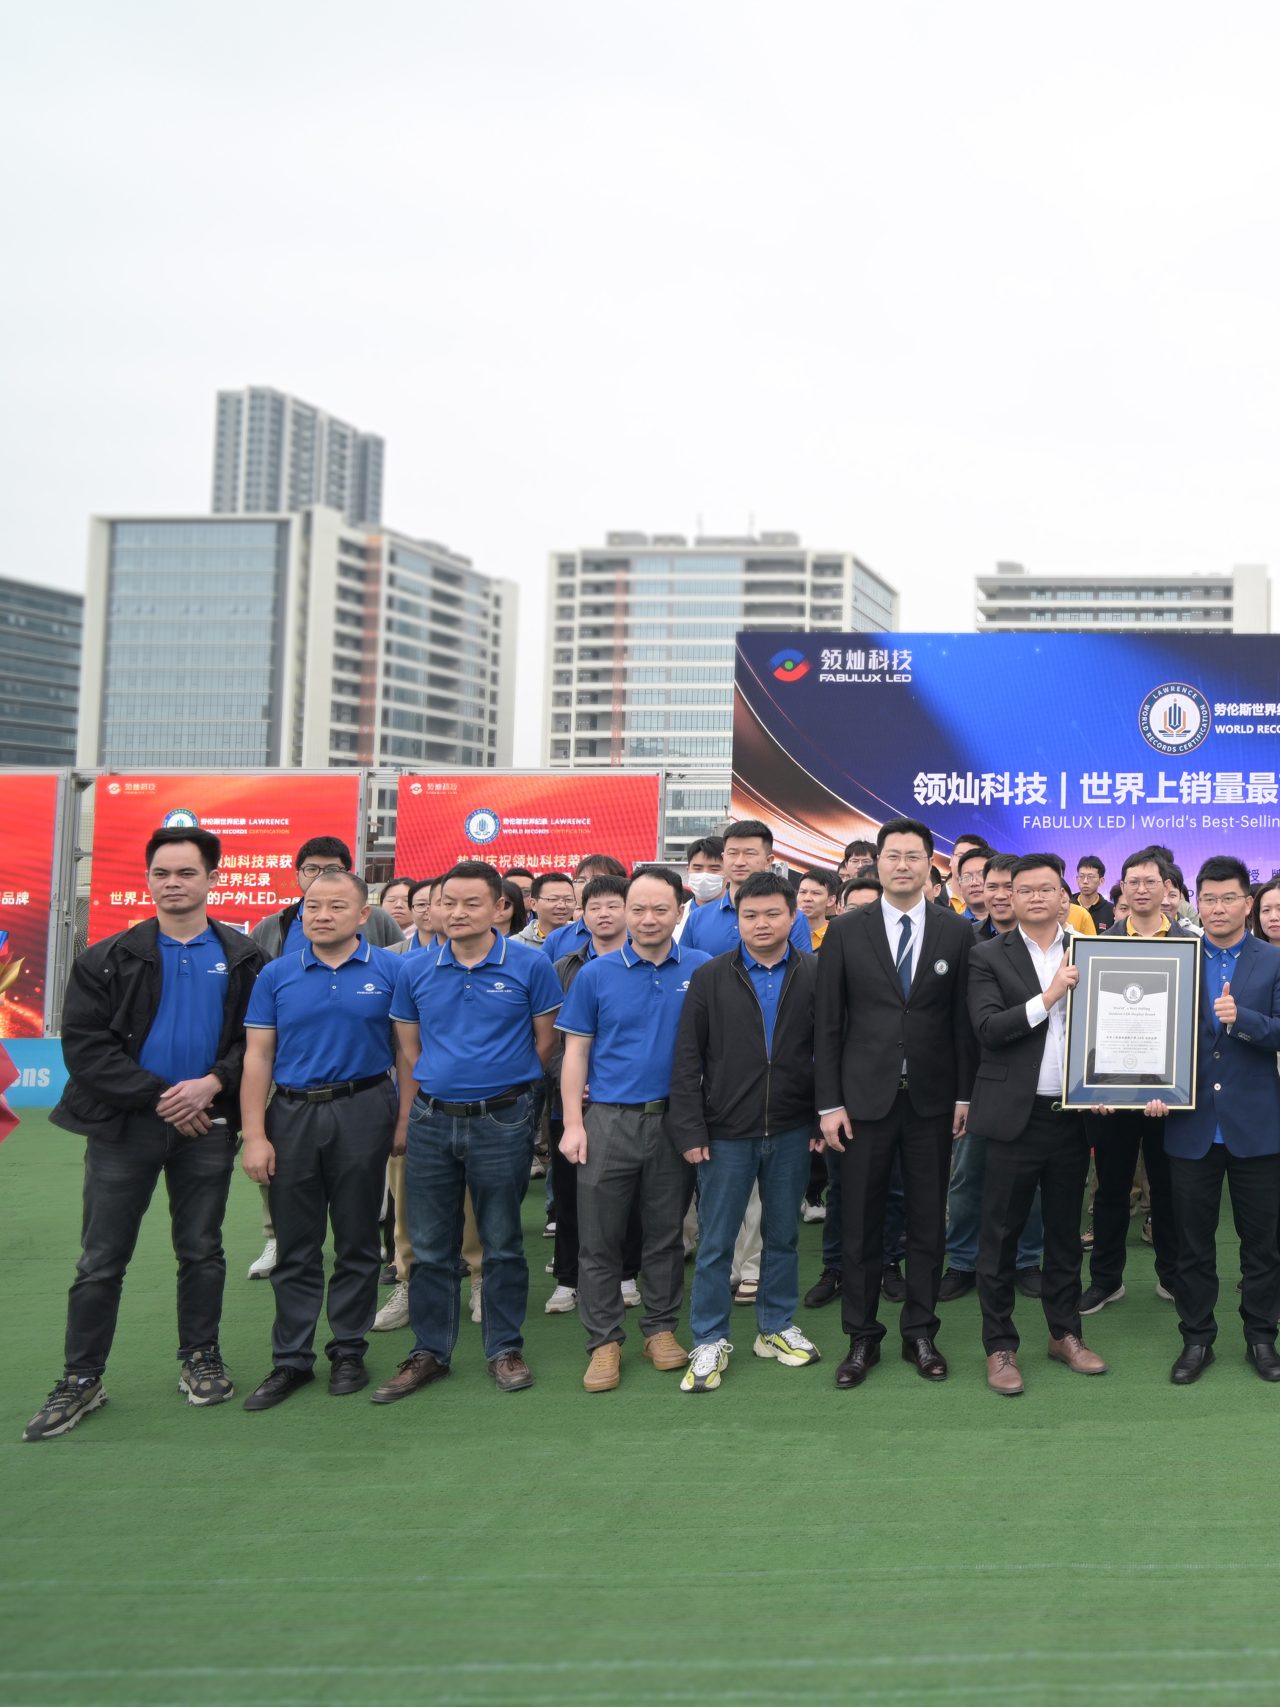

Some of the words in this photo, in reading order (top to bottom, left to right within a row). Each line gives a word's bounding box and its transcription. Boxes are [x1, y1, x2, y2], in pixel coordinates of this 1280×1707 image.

[820, 649, 912, 671] 领灿科技
[819, 673, 882, 683] FABULUX
[885, 673, 912, 683] LED
[1152, 685, 1198, 700] LAWRENCE
[1141, 704, 1151, 731] WORLD
[1146, 732, 1177, 753] RECORDS
[1179, 704, 1209, 752] CERTIFICATION
[1215, 725, 1254, 734] WORLD
[913, 771, 1048, 806] 领灿科技
[1023, 816, 1093, 829] FABULUX
[1098, 816, 1126, 829] LED
[1141, 815, 1197, 829] World's
[0, 891, 30, 905] 品牌
